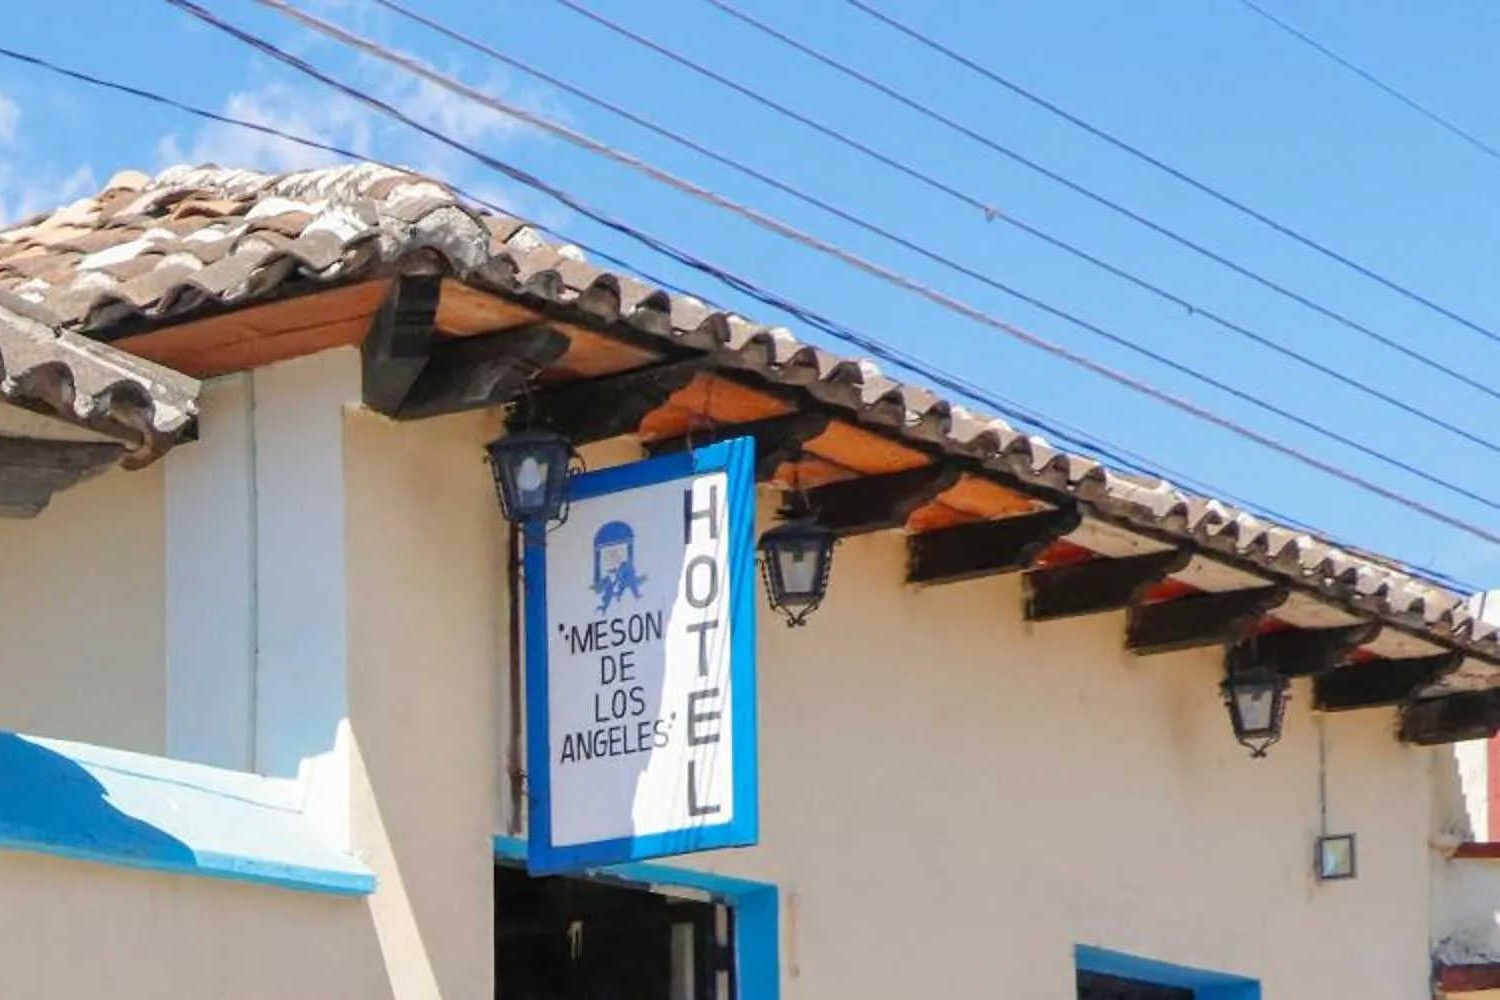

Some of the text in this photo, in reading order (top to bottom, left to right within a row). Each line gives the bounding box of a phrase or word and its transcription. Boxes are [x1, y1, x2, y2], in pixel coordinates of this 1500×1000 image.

[601, 651, 636, 685] DE
[683, 485, 721, 817] HOTEL
[595, 686, 646, 723] LOS
